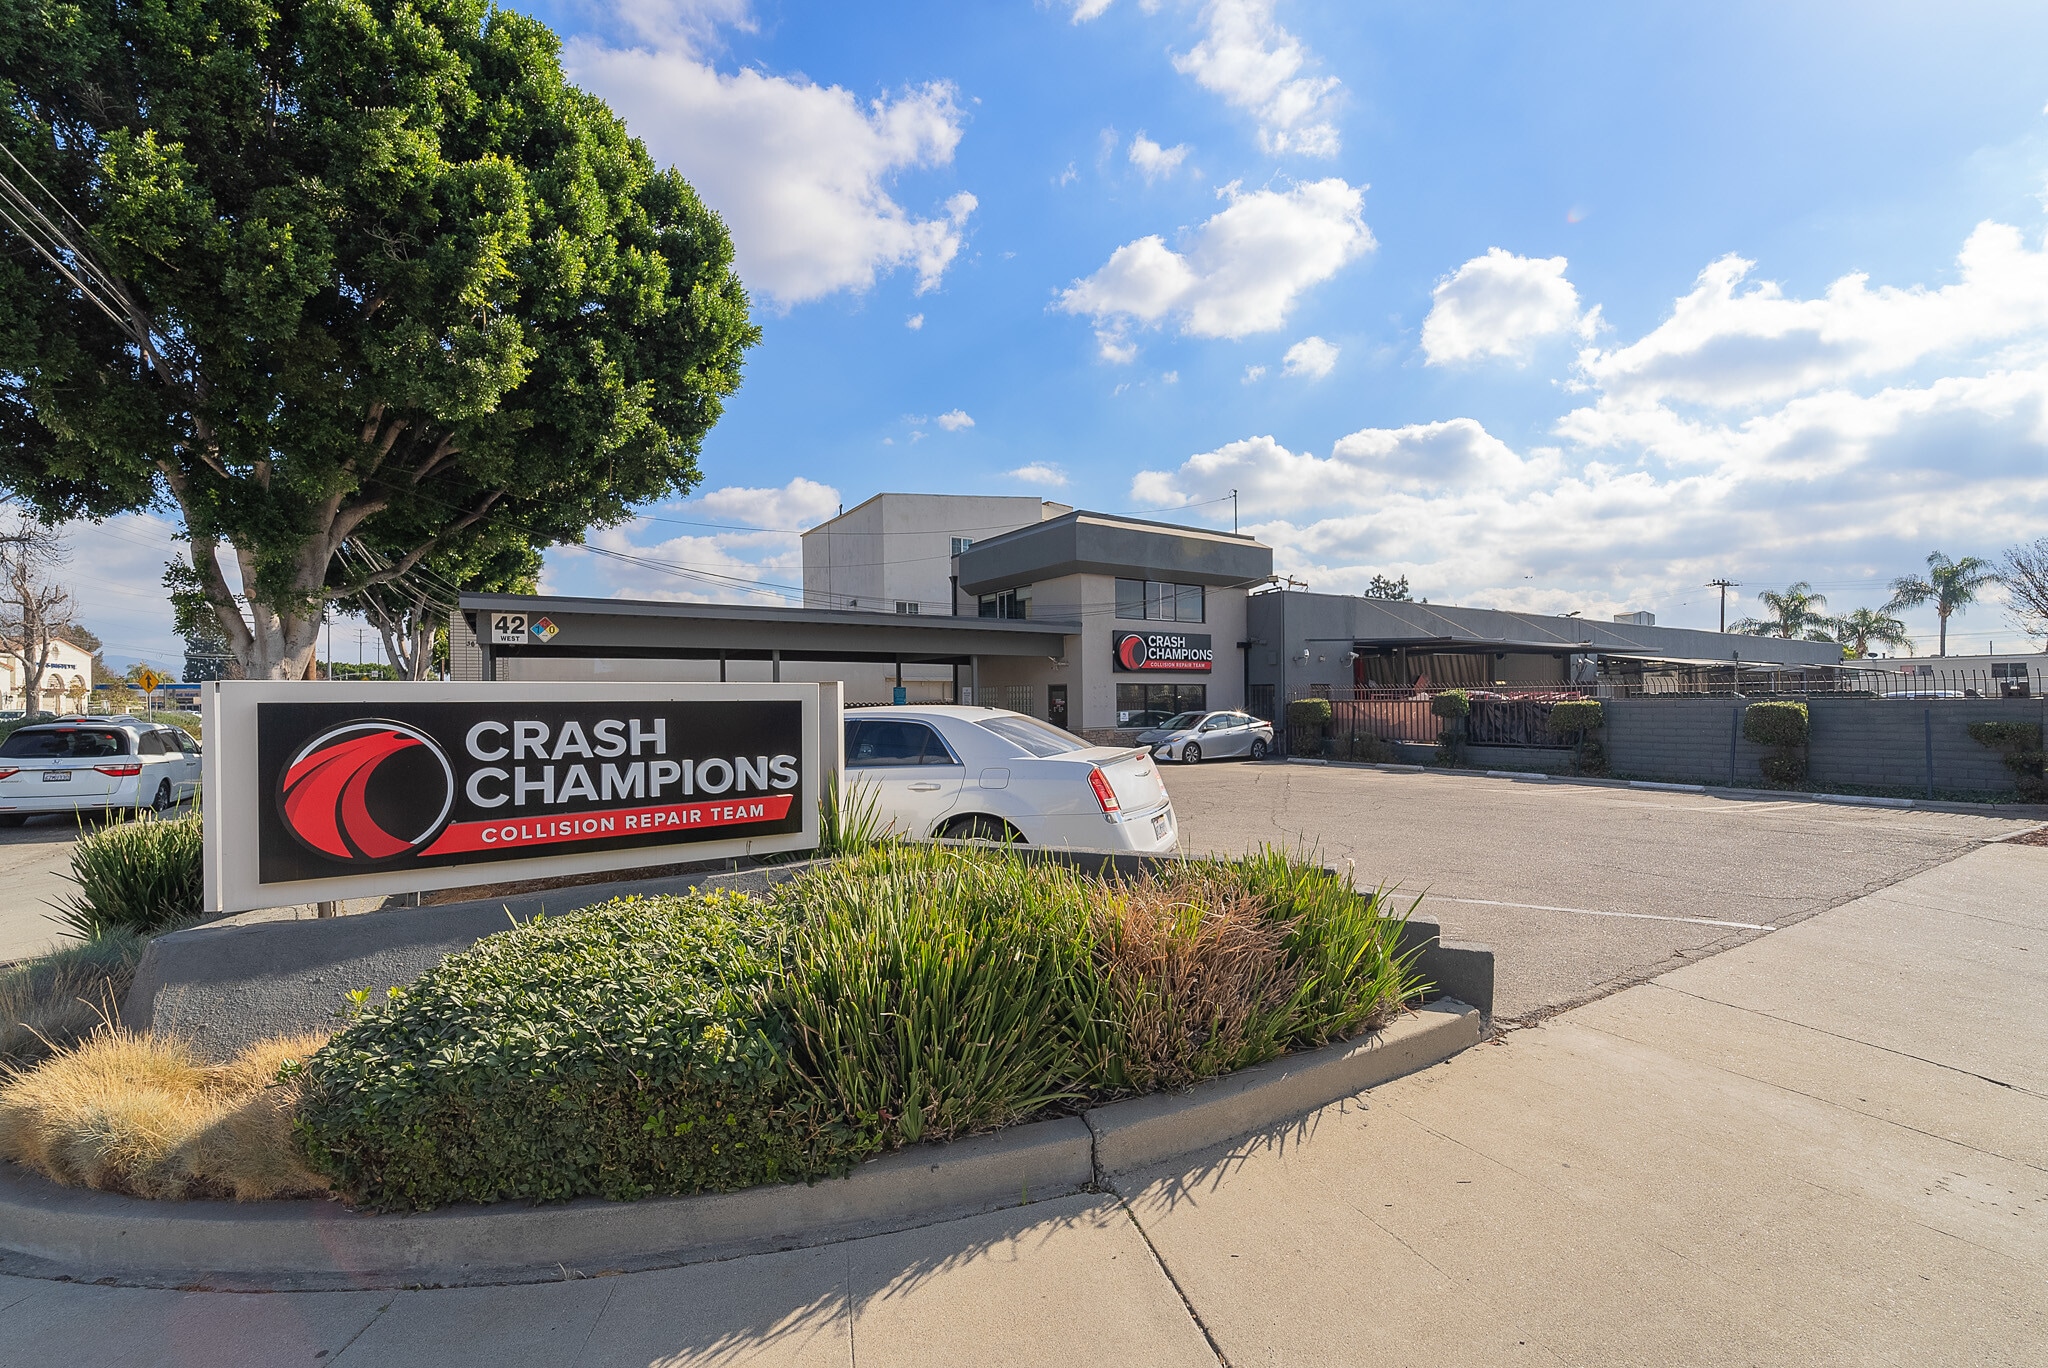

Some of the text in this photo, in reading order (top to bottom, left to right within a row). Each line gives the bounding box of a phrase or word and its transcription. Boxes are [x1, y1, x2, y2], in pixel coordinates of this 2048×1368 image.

[494, 616, 525, 634] 42
[549, 625, 555, 633] 0
[1148, 635, 1186, 648] CRASH
[1148, 647, 1213, 660] CHAMPIONS
[465, 718, 667, 762] CRASH
[465, 754, 799, 808] CHAMPIONS
[481, 804, 765, 843] COLLISION REPAIR TEAM
